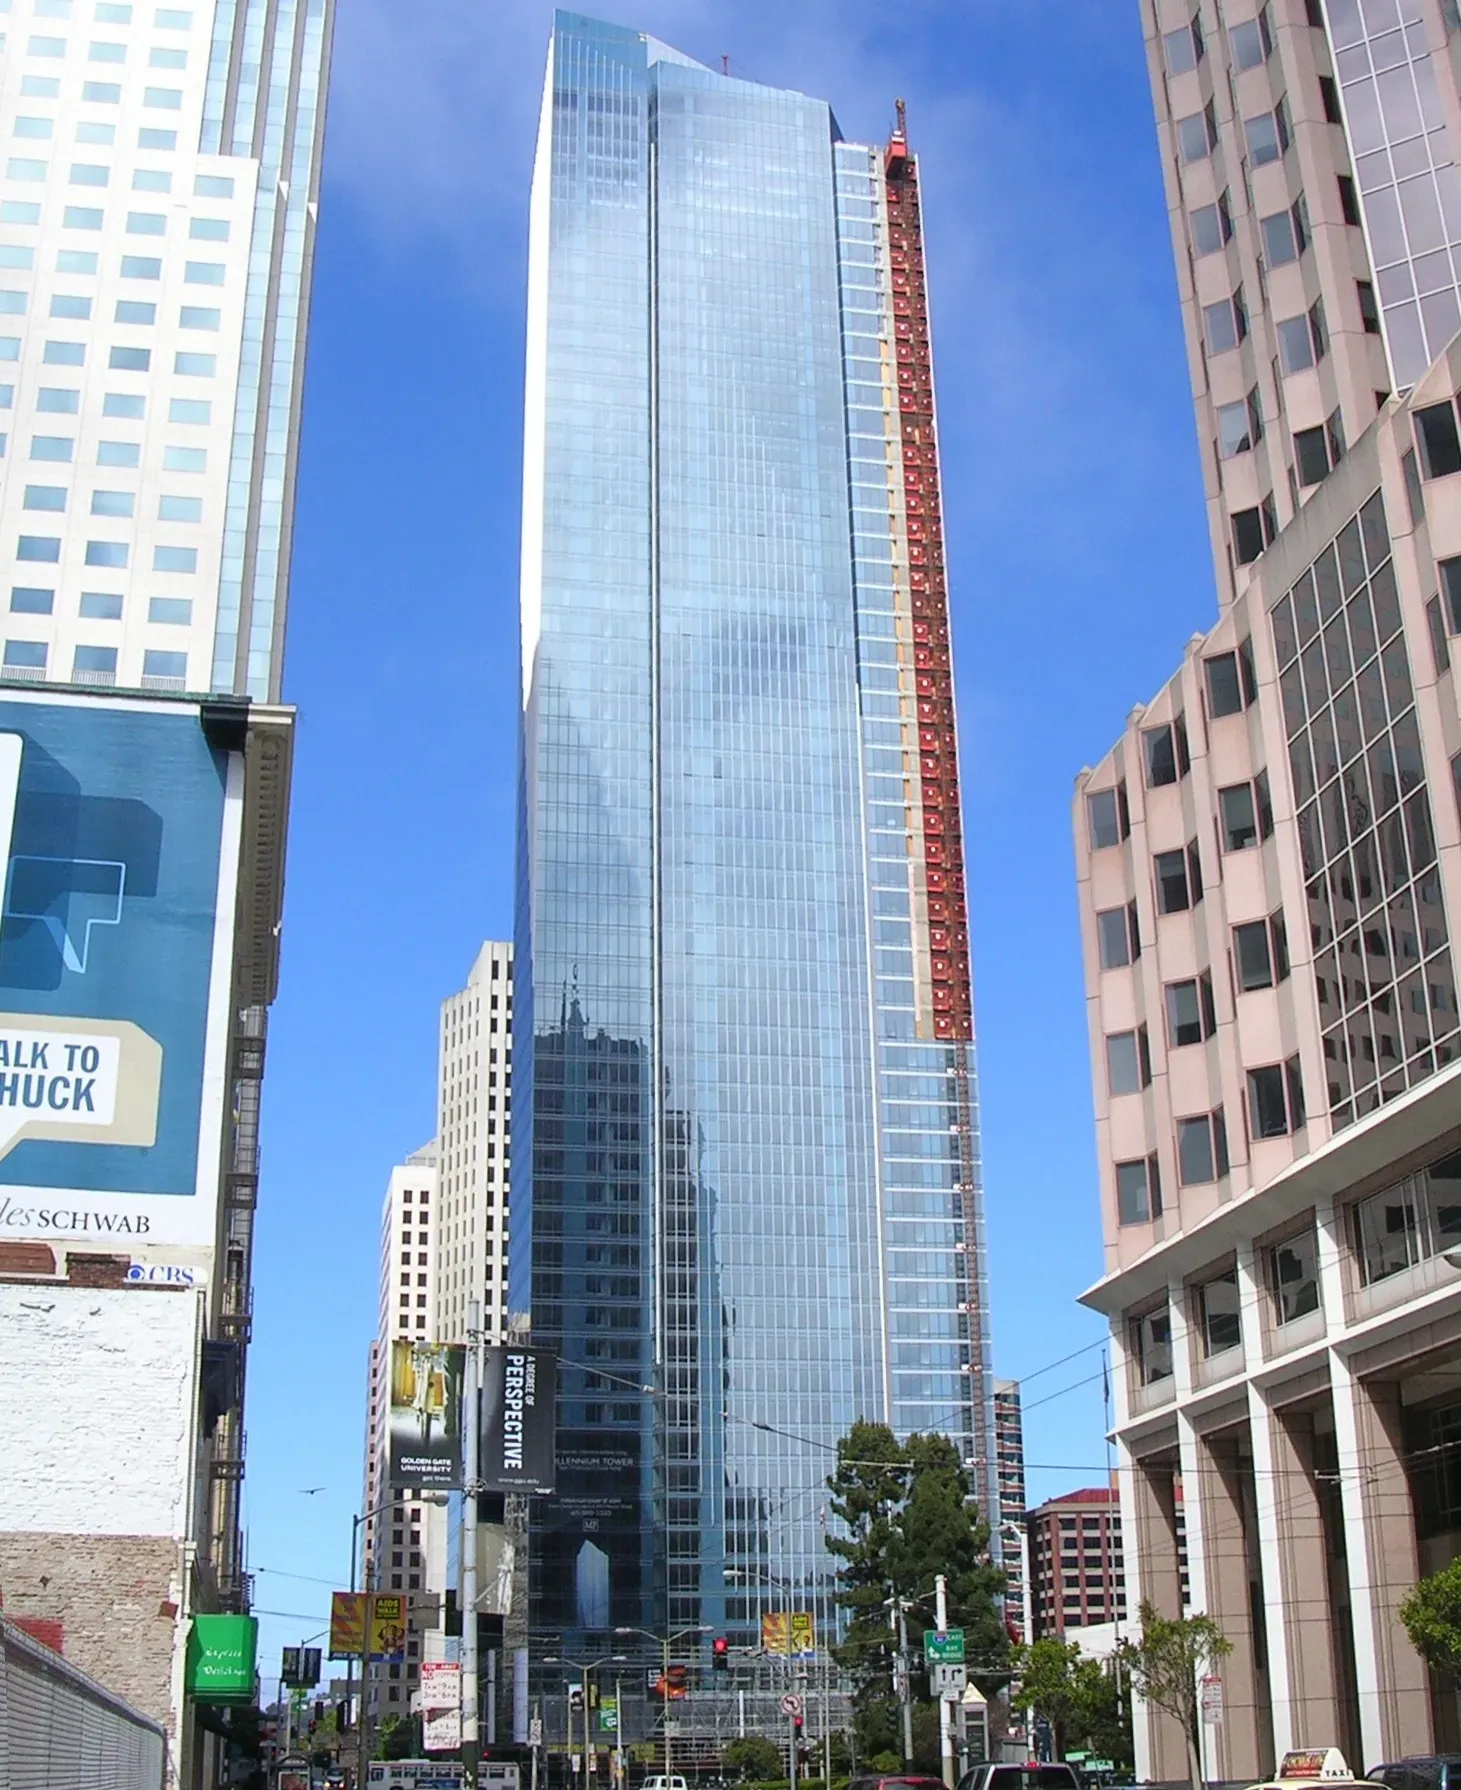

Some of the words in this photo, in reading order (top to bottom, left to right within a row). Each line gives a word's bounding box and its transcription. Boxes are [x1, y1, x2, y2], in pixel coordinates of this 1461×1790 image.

[64, 1044, 100, 1074] TO
[37, 1209, 150, 1234] SCHWAB
[525, 1363, 536, 1393] DEGREE
[524, 1395, 535, 1407] OF
[503, 1354, 525, 1470] PERSPECTIVE
[400, 1457, 431, 1465] GOLDEN
[432, 1458, 452, 1466] GATE
[400, 1465, 452, 1473] UNIVERSITY
[602, 1457, 635, 1466] TOWER
